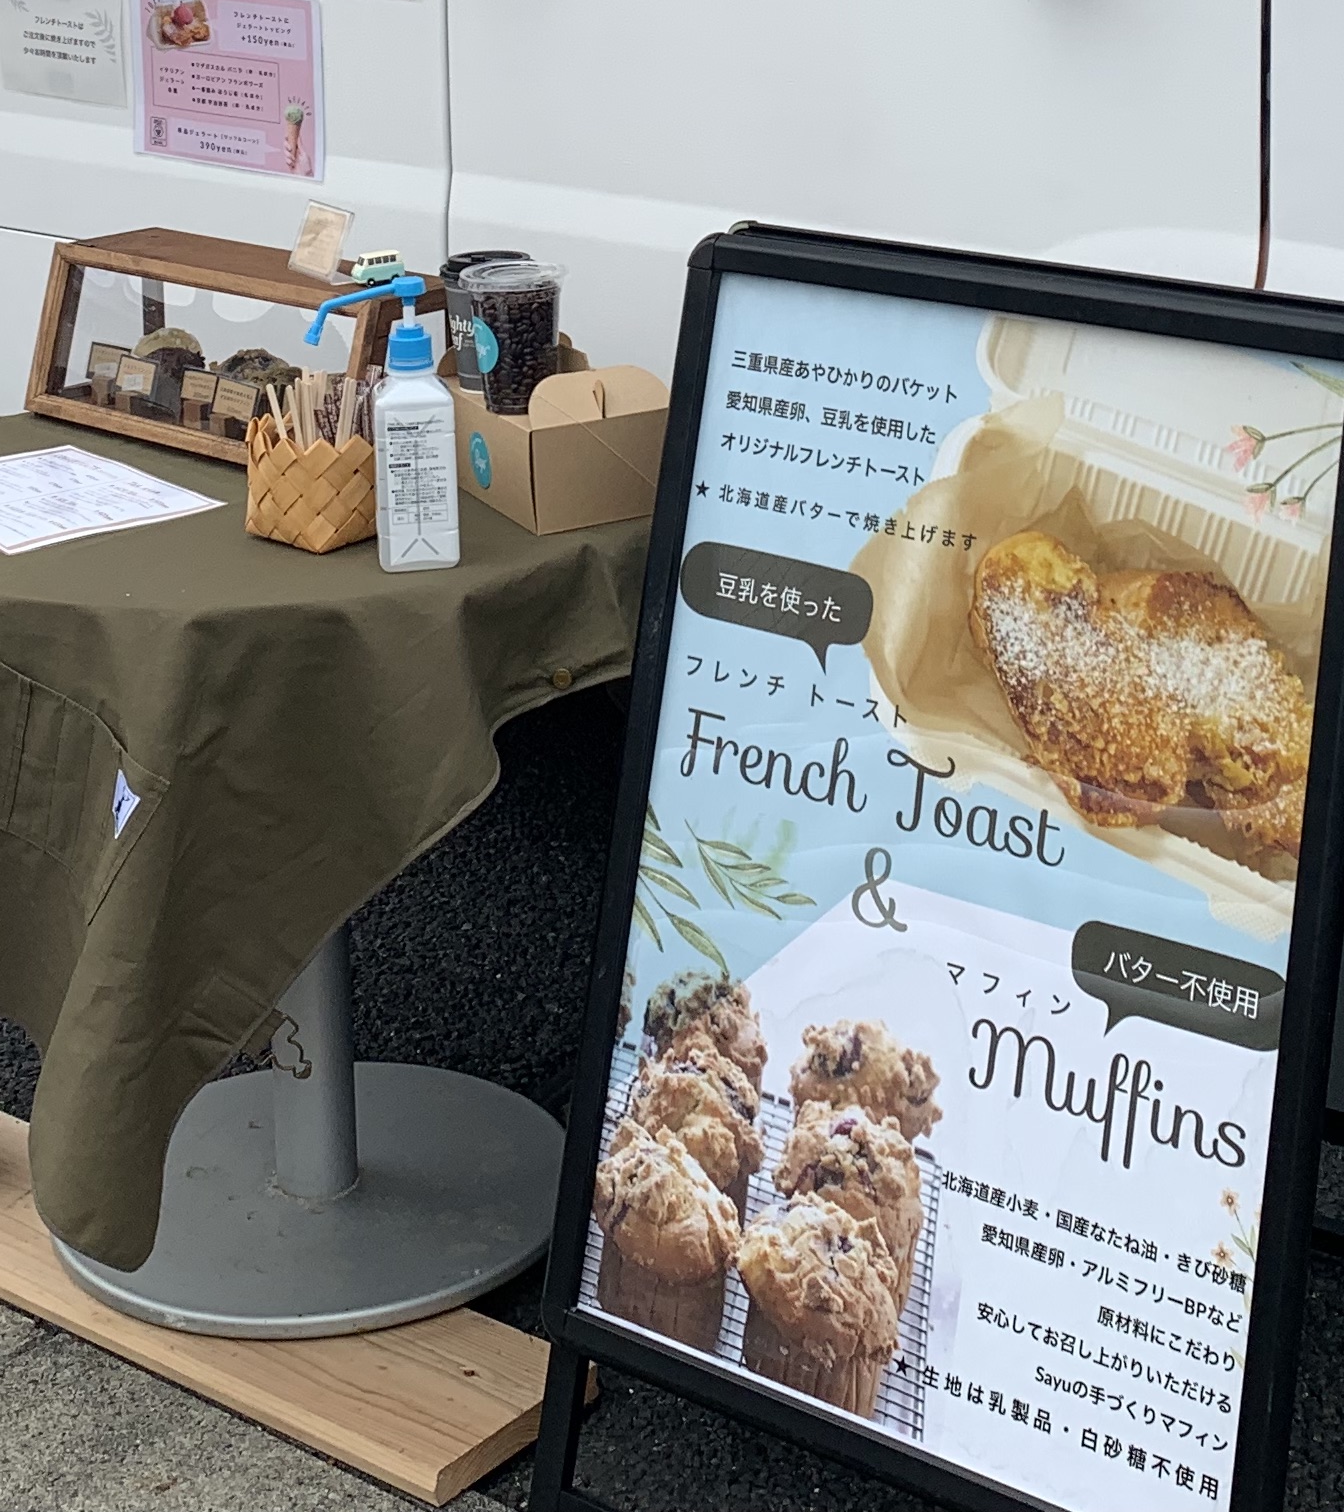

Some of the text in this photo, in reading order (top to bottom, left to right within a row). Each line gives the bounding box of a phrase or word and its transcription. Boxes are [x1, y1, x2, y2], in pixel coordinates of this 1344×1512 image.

[730, 349, 959, 403] 三重県産あやひかりのバケット
[725, 390, 937, 445] 愛知県産卵、豆乳を使用した
[719, 431, 926, 487] オリジナルフレンチトースト
[718, 484, 978, 552] 北海道産バターで焼き上げます
[716, 571, 843, 624] 豆乳を使った
[687, 654, 909, 728] フレンチ トースト
[679, 708, 1066, 868] French Toast
[850, 846, 908, 933] &
[946, 962, 1072, 1017] マフィン
[1103, 949, 1261, 1021] バター不使用
[941, 1169, 1248, 1297] 北海道産小麦・国産なたね油・きび砂糖
[981, 1221, 1244, 1335] 愛知県産卵・アルミフリーBPなど
[976, 1299, 1234, 1416] 安心してお召し上がりいただける
[1096, 1304, 1238, 1374] 原材料にこだわり
[922, 1363, 1222, 1501] 生地は乳製品・白砂糖不使用
[1034, 1363, 1230, 1455] Sayuの手づくりマフィン
